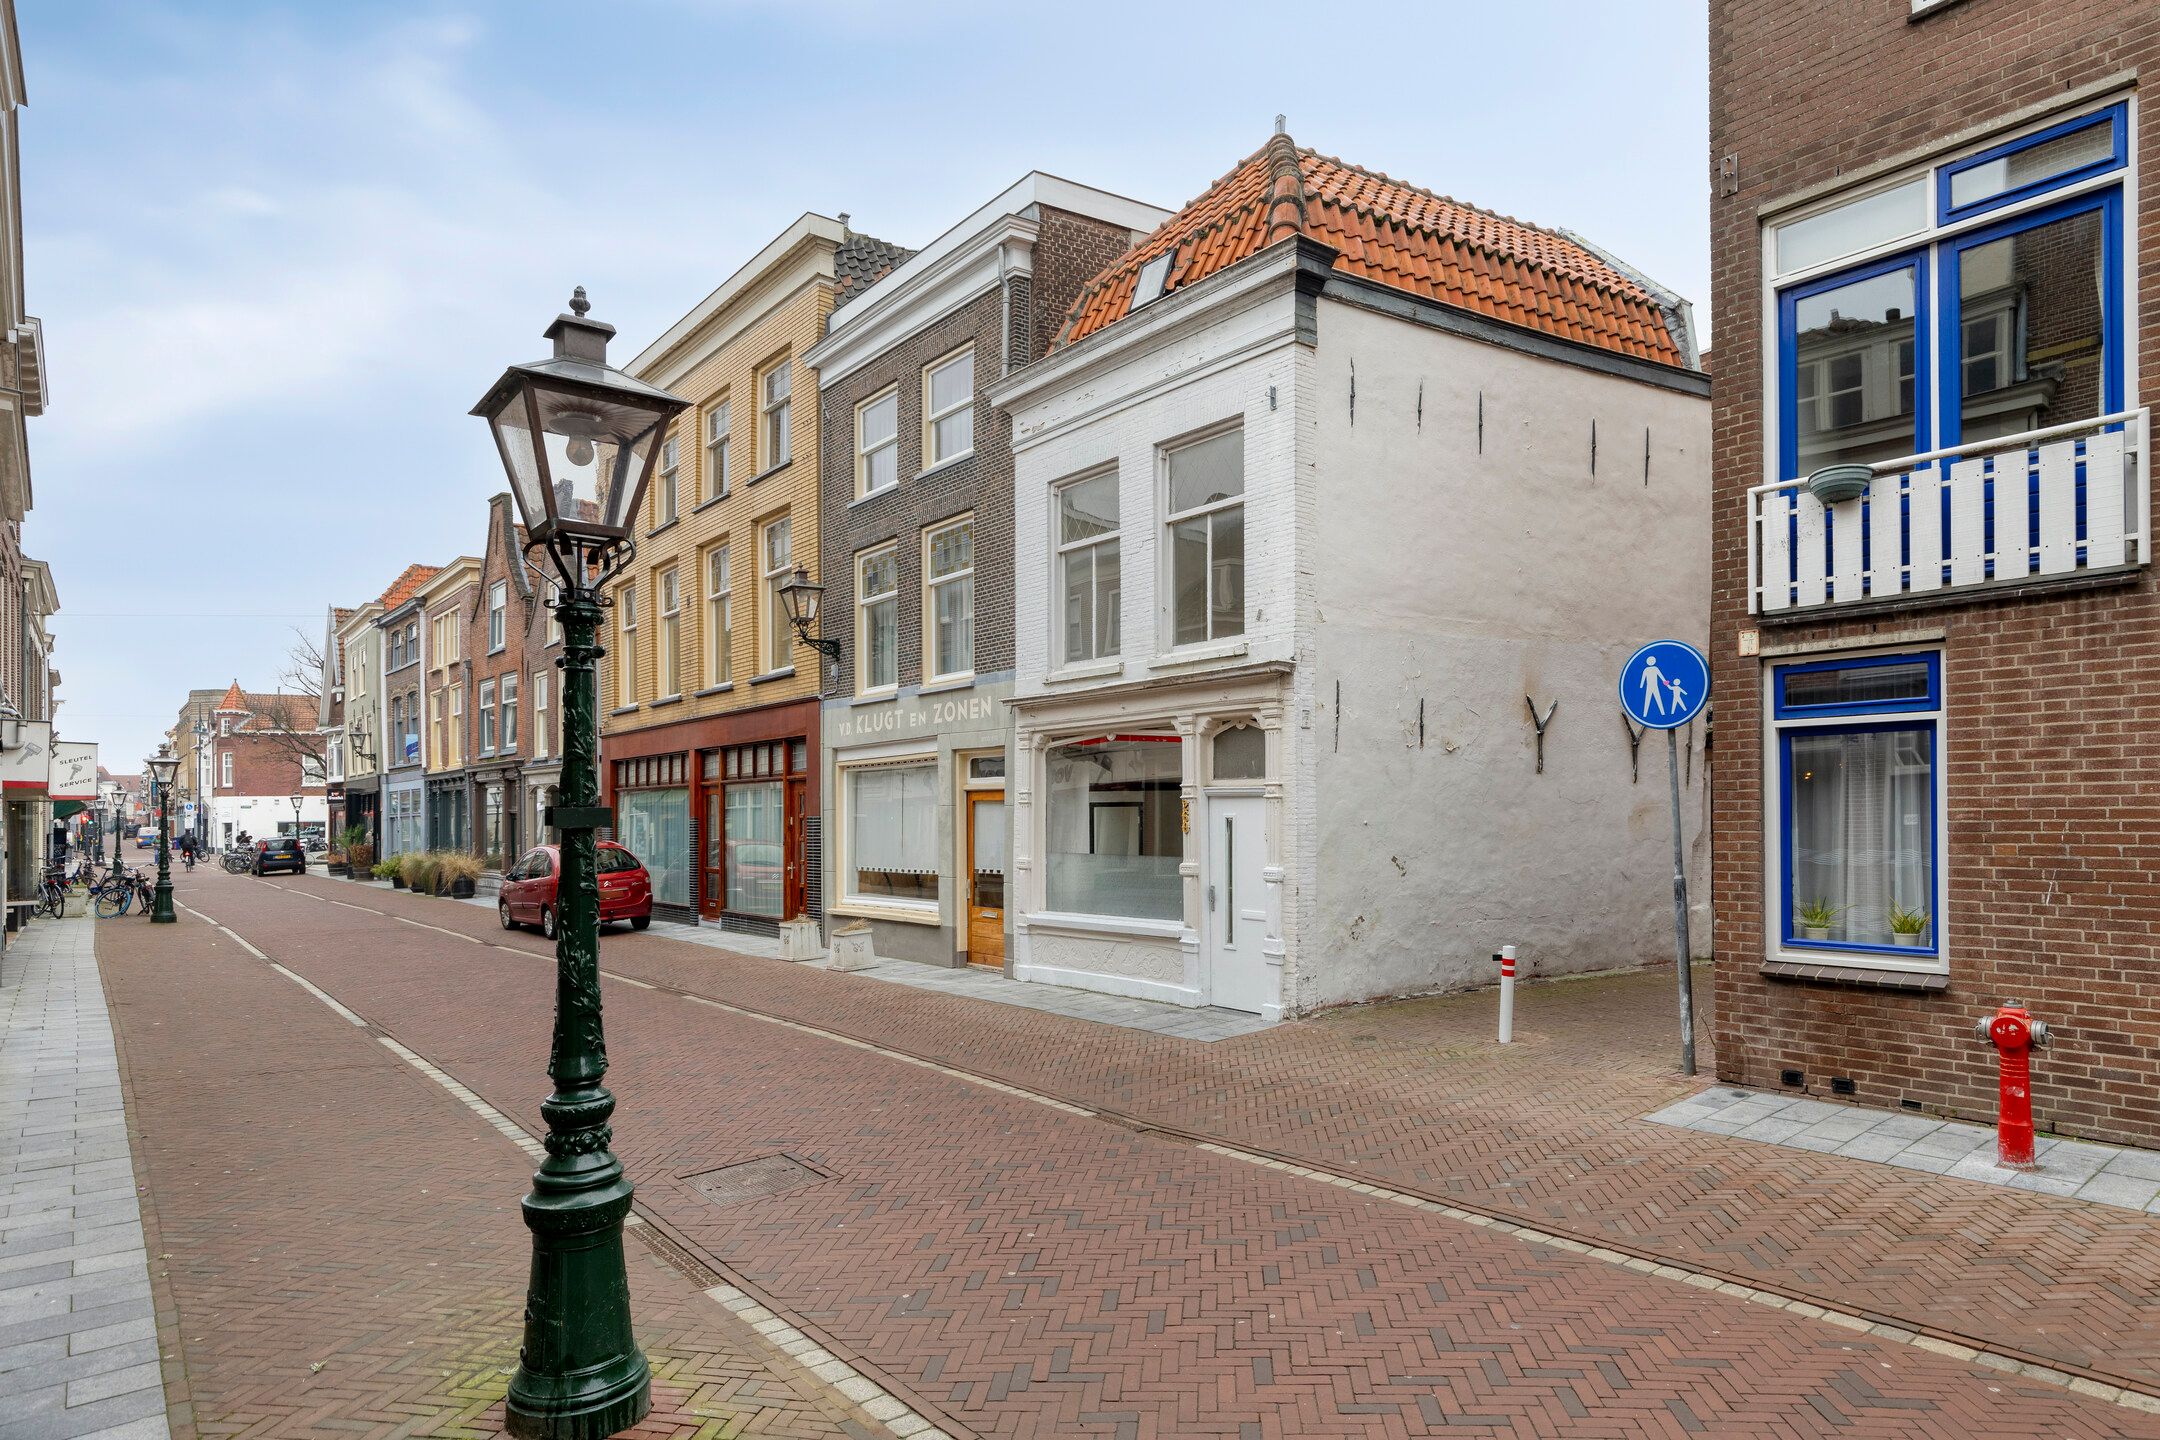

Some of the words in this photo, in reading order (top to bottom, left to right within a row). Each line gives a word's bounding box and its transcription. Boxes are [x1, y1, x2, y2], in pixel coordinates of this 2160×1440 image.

[856, 709, 904, 734] KLUGT
[909, 712, 927, 728] EN
[932, 696, 992, 724] ZONEN
[59, 755, 93, 766] SLEUTEL
[59, 777, 92, 788] SERVICE
